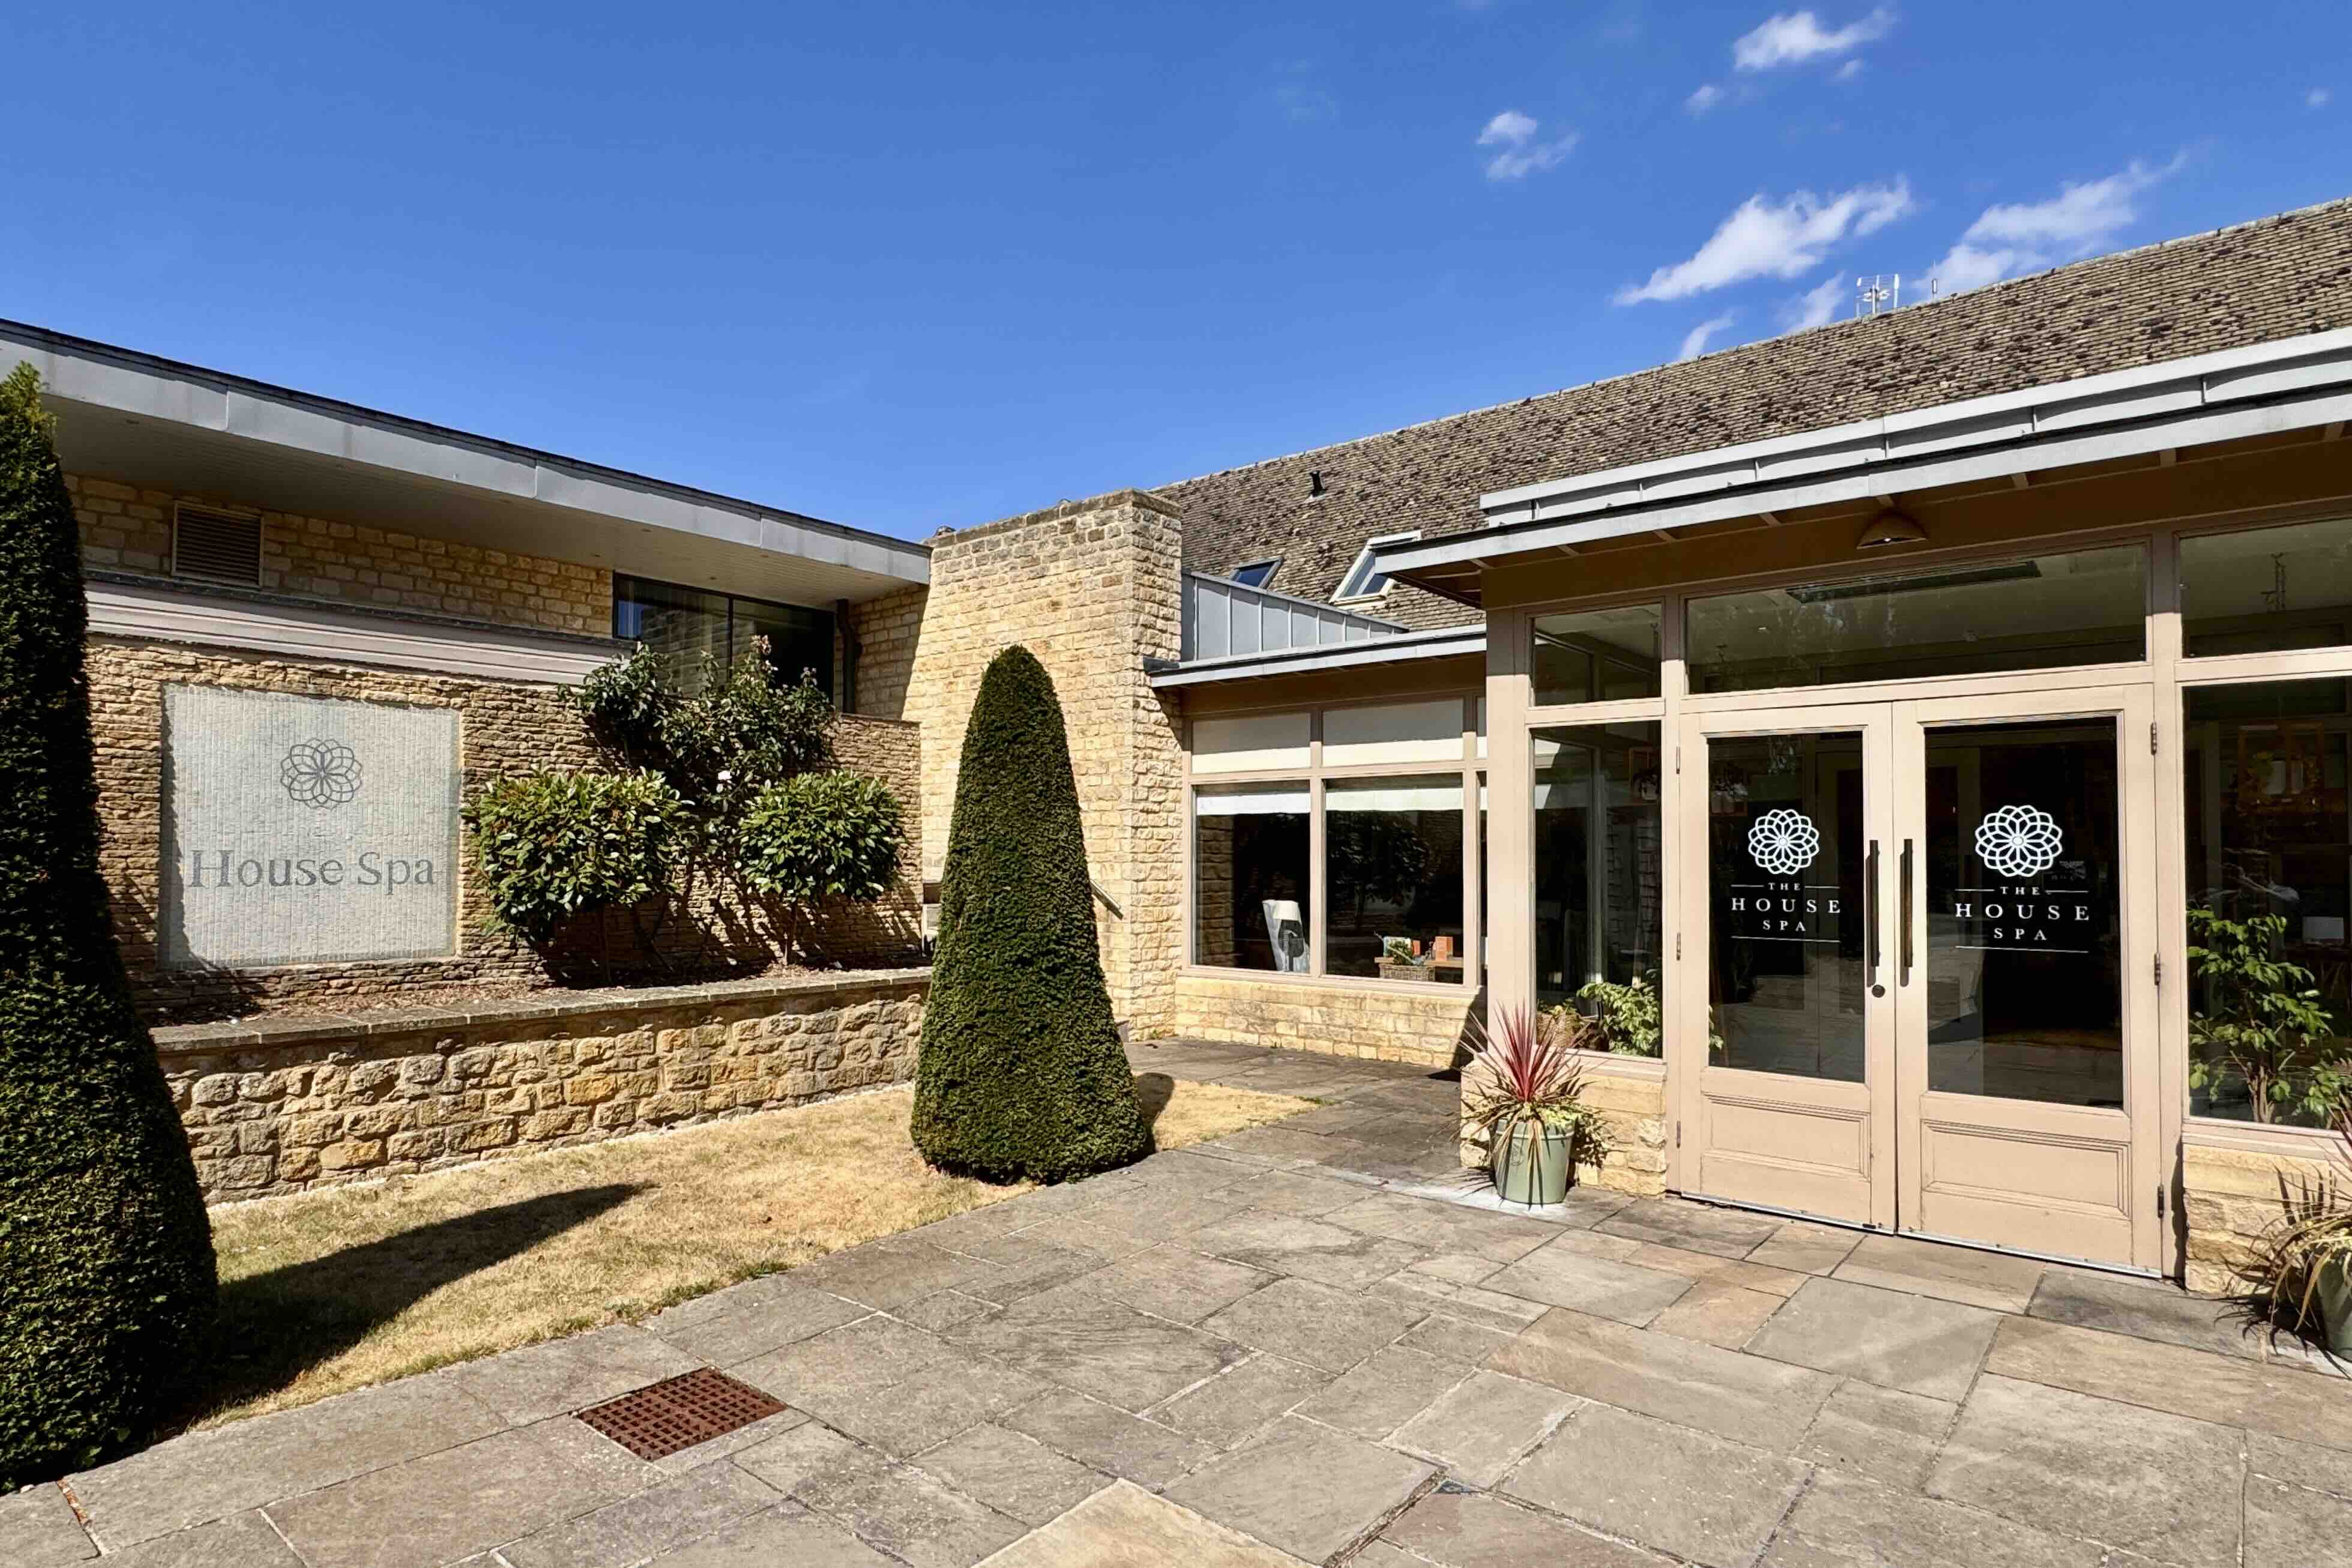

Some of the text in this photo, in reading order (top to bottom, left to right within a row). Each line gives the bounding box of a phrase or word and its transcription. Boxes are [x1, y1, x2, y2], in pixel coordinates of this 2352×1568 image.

[190, 849, 434, 896] House Spa
[1768, 882, 1800, 891] THE
[2000, 886, 2040, 895] THE
[1731, 897, 1841, 914] HOUSE
[1955, 903, 2089, 921] HOUSE
[1762, 920, 1806, 932] SPA
[1994, 927, 2046, 941] SPA
